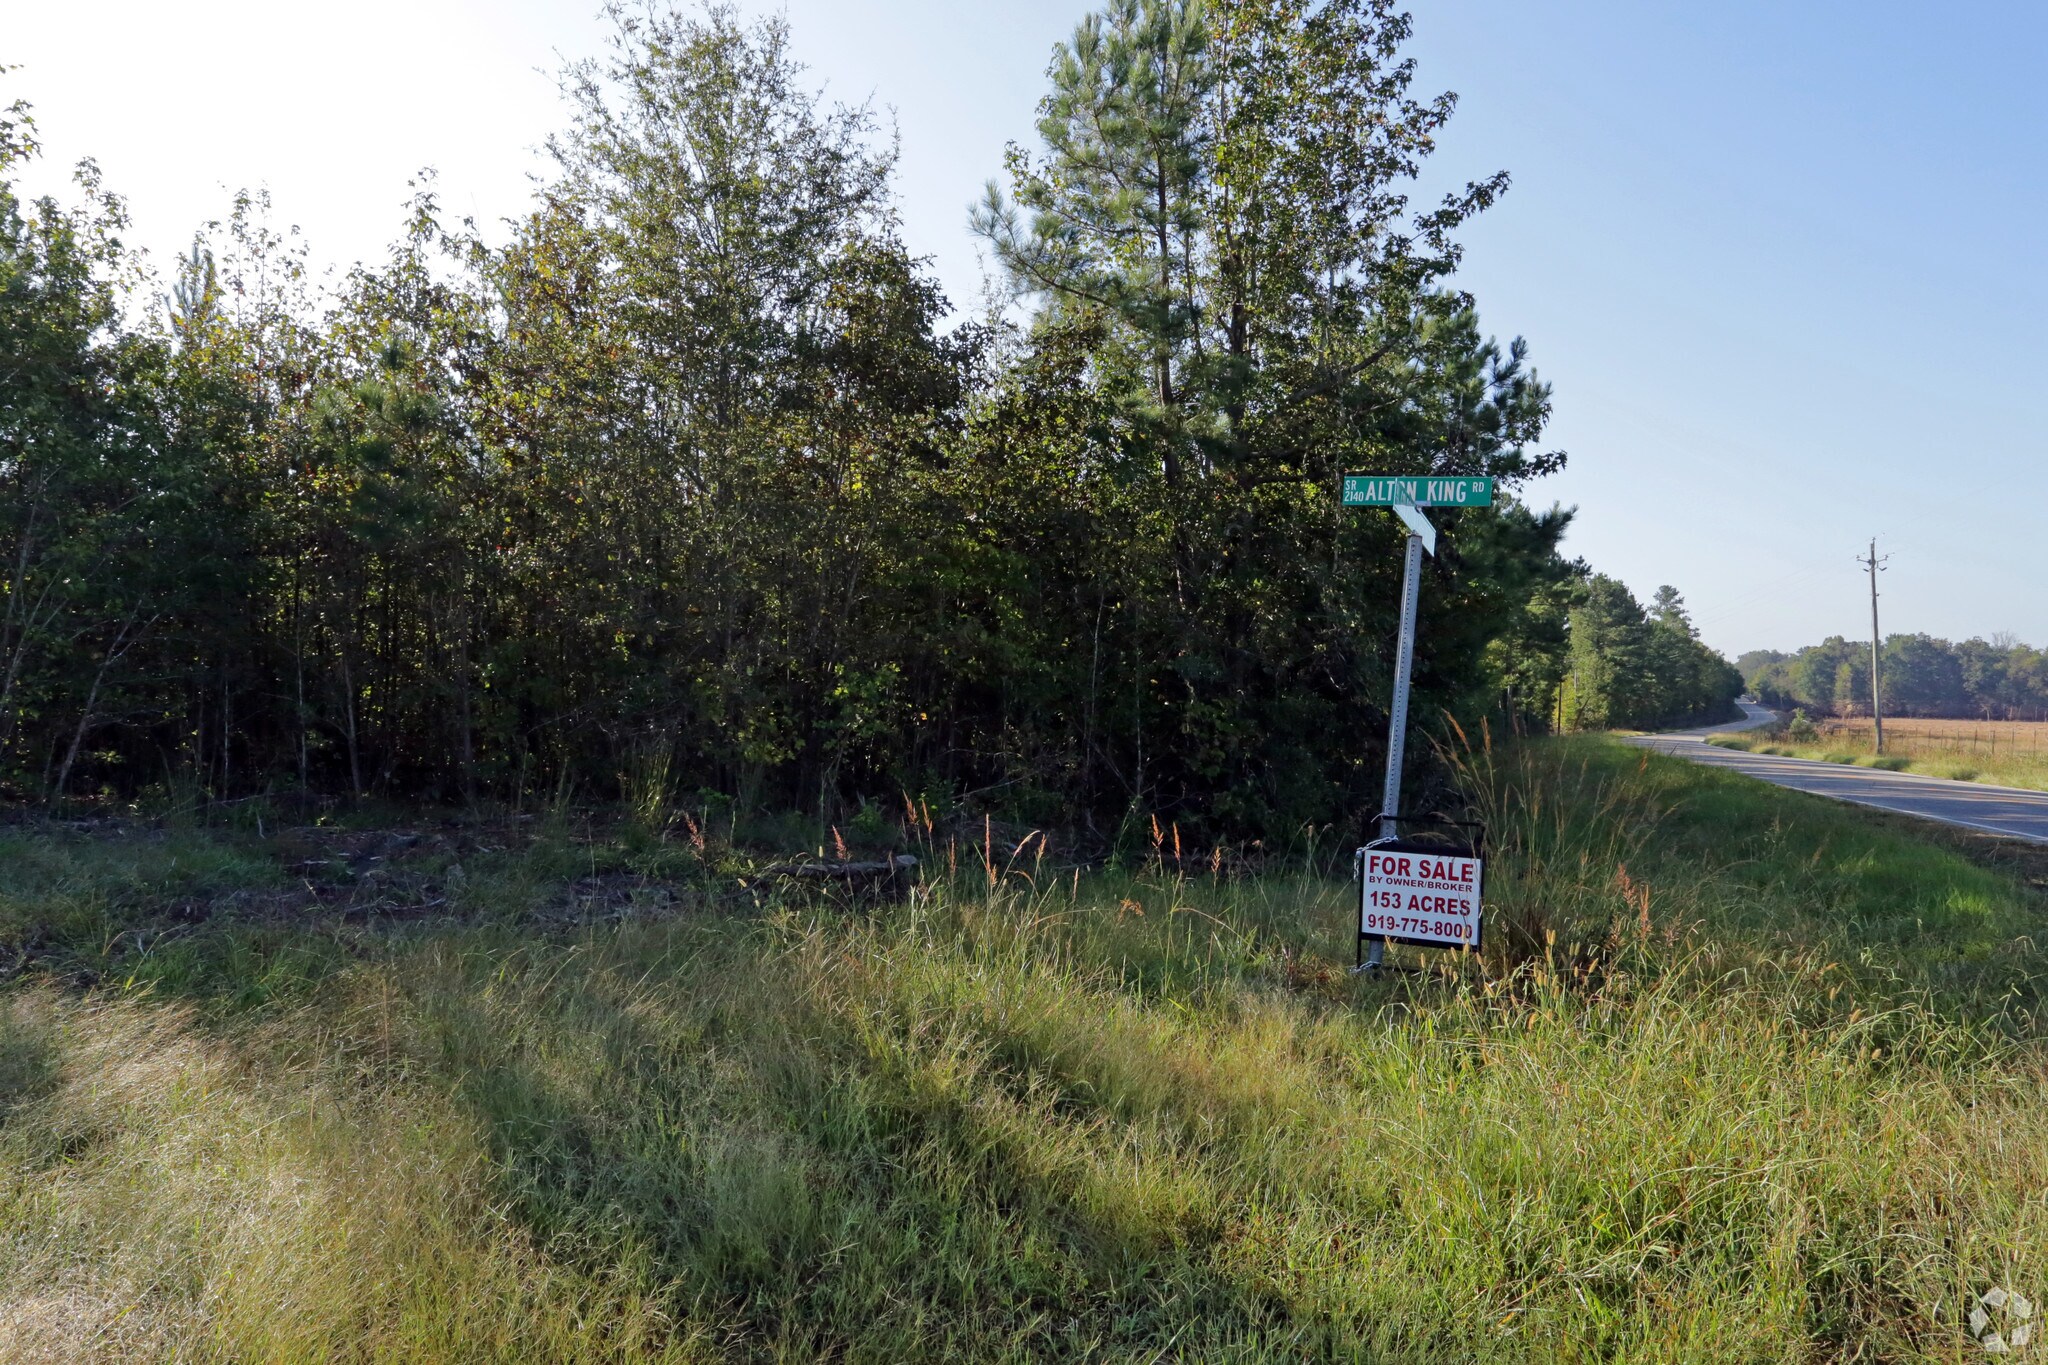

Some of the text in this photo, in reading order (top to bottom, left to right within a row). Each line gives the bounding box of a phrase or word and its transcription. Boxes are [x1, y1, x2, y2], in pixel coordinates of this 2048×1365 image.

[1345, 479, 1357, 491] SR
[1365, 480, 1485, 503] ALTN KING RD
[1344, 491, 1364, 502] 2140
[1369, 855, 1474, 883] FOR SALE
[1369, 875, 1473, 893] BY OWNER/BROKER
[1370, 890, 1471, 916] 153 ACRES
